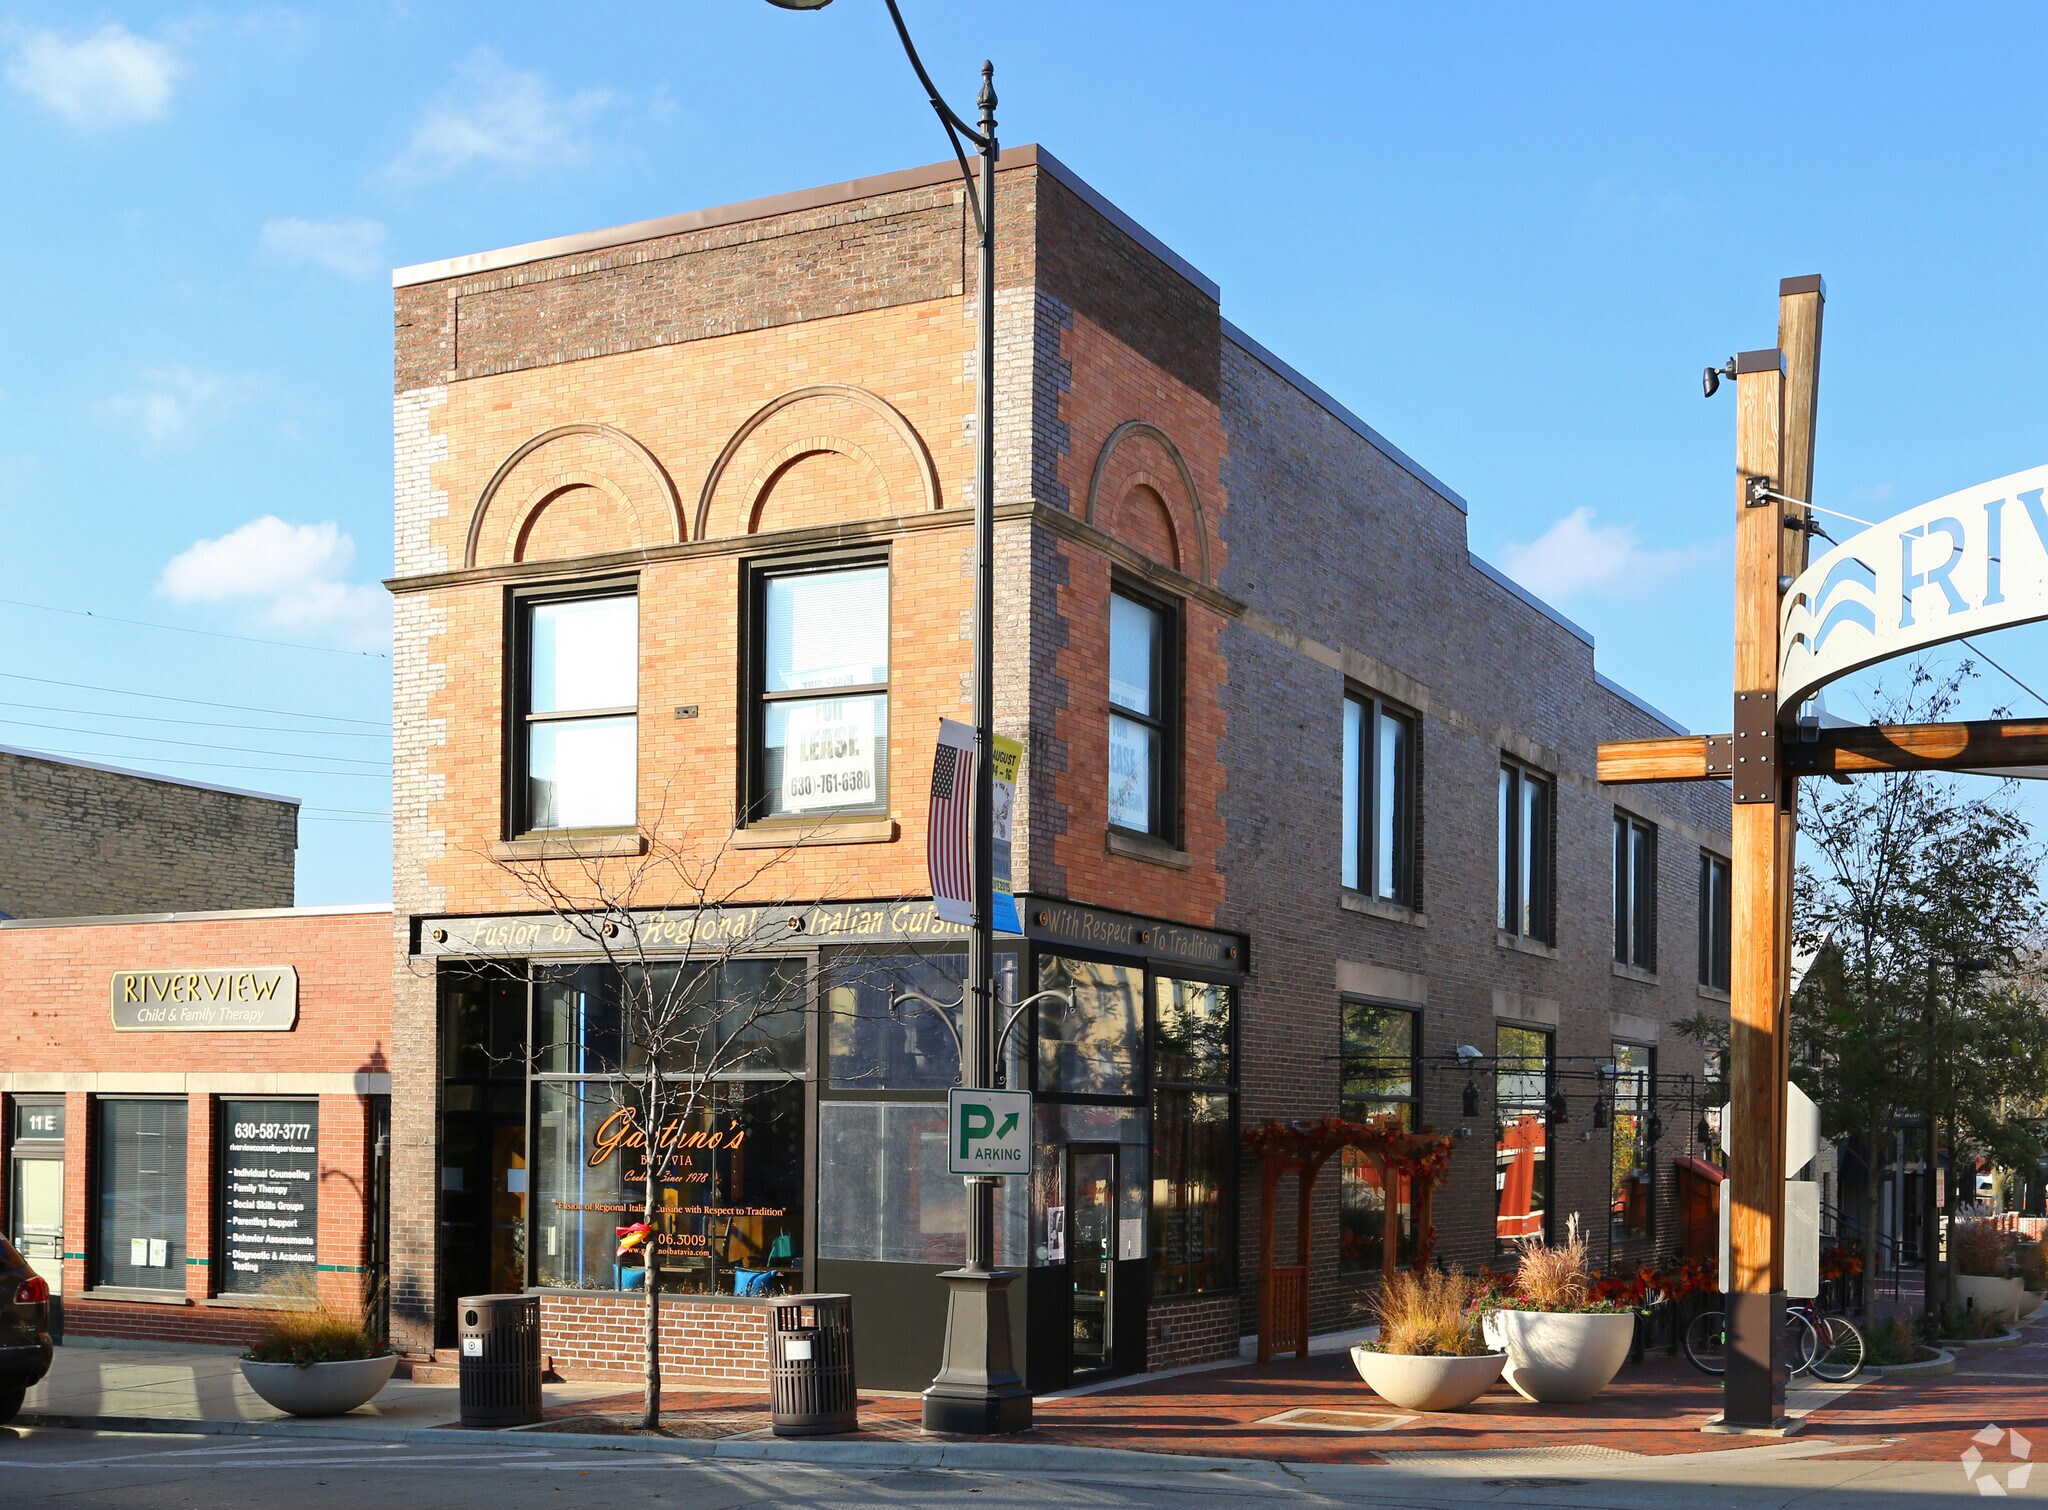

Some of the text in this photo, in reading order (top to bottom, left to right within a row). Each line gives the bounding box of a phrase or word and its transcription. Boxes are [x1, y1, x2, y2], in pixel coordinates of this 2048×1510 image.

[800, 726, 860, 762] LEASE
[992, 749, 1017, 767] AUGUST
[1110, 743, 1136, 778] EASE
[1005, 767, 1013, 781] 16
[552, 915, 582, 944] of
[640, 909, 757, 944] Regional
[809, 906, 885, 935] Italian
[891, 904, 971, 934] Cuis
[1047, 908, 1079, 940] With
[1082, 912, 1134, 945] Respect
[1152, 926, 1166, 950] To
[124, 973, 281, 1003] RIVERVIEW
[137, 1007, 264, 1024] Child & Family Therapy
[234, 1122, 311, 1140] 630-587-3777
[588, 1106, 745, 1166] Gatno's
[229, 1143, 315, 1154] riverviewcounselingservices.com
[641, 1155, 692, 1166] BTVIA
[233, 1168, 268, 1177] Individual
[269, 1169, 310, 1181] Counseling
[660, 1170, 683, 1183] Since
[685, 1172, 709, 1184] 1978
[233, 1183, 257, 1194] Family
[258, 1184, 288, 1195] Therapy
[233, 1199, 255, 1209] Social
[256, 1200, 276, 1210] Skills
[277, 1201, 304, 1212] Groups
[584, 1202, 594, 1211] of
[594, 1202, 627, 1213] Regional
[628, 1203, 646, 1212] Italia
[685, 1206, 702, 1214] with
[704, 1207, 734, 1216] Respect
[233, 1216, 267, 1228] Parenting
[268, 1218, 298, 1228] Support
[232, 1233, 265, 1243] Behavior
[265, 1234, 314, 1245] Assessments
[232, 1249, 270, 1260] Diagnostic
[271, 1251, 277, 1261] &
[279, 1251, 315, 1262] Academic
[232, 1261, 258, 1273] Testing
